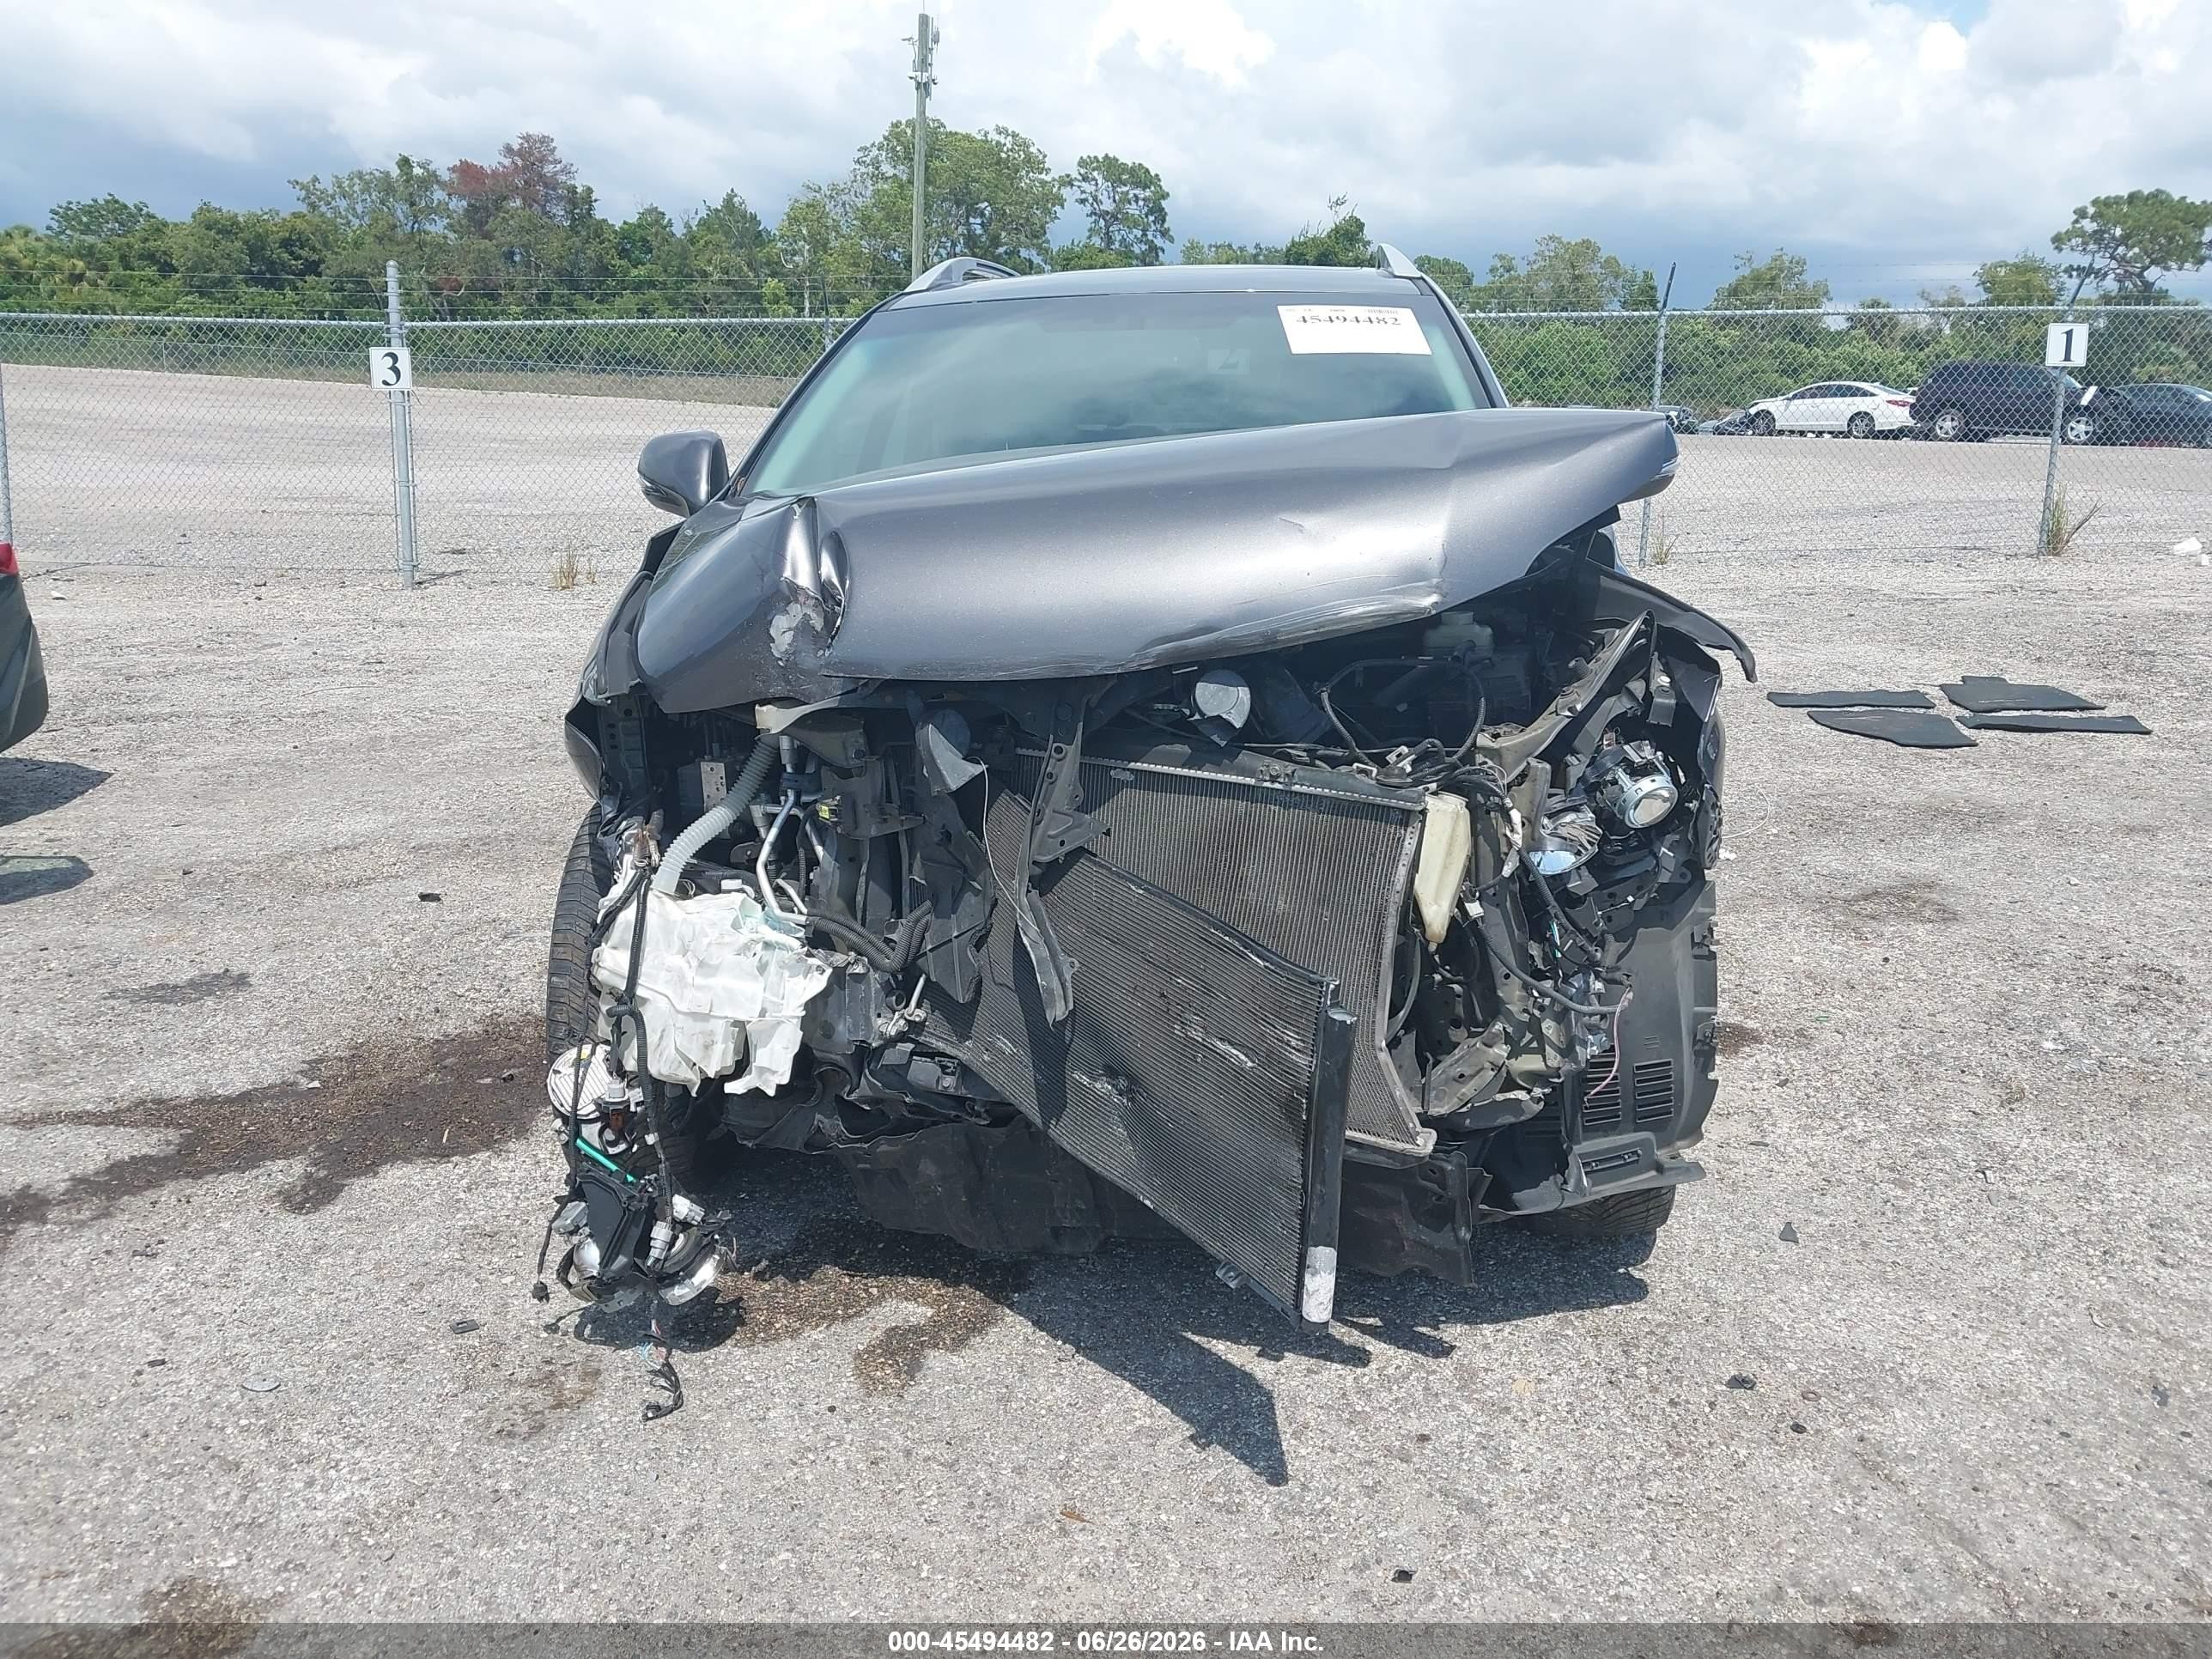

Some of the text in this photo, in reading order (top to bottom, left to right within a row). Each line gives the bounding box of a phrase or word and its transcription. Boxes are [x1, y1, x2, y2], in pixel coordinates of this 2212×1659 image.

[1295, 314, 1402, 325] 45494482
[2059, 328, 2075, 362] 1
[381, 351, 401, 386] 3
